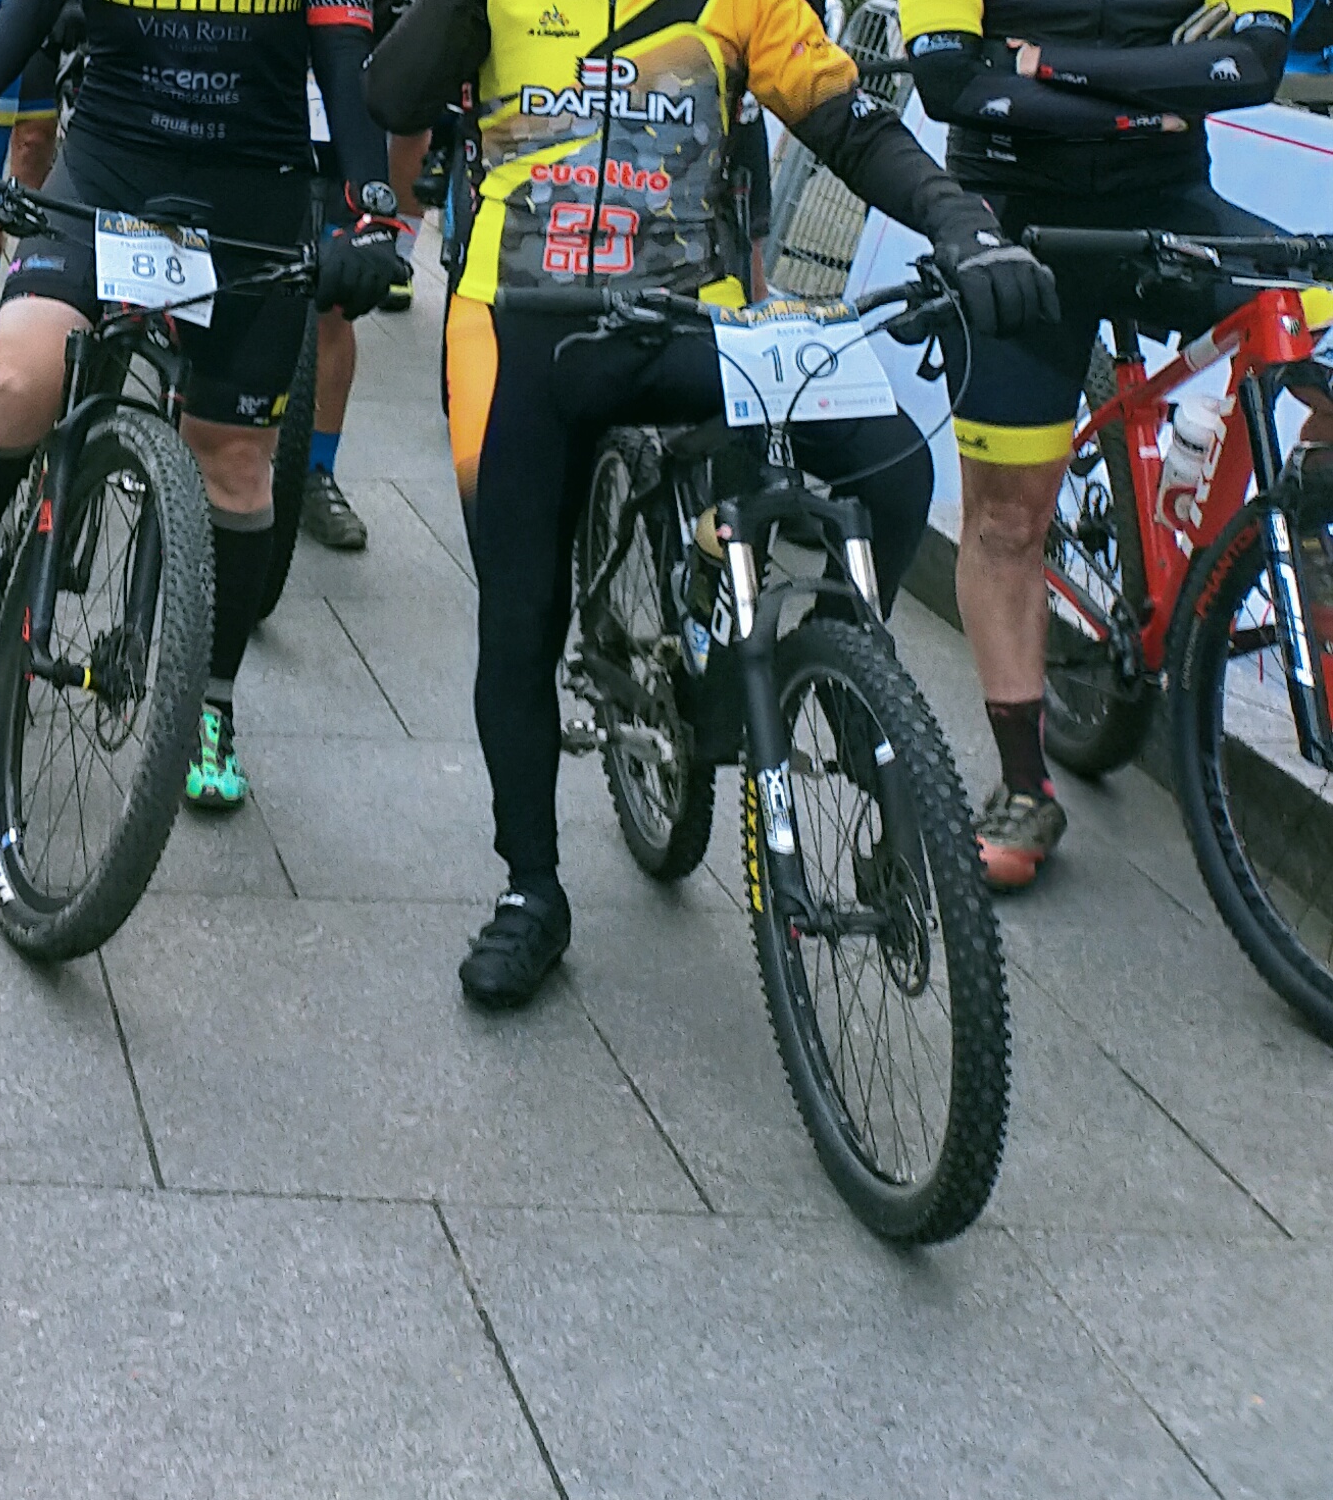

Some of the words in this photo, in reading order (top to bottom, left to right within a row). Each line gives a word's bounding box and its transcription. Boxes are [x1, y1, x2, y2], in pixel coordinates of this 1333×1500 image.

[160, 68, 242, 92] cenor
[133, 252, 186, 285] 88
[761, 342, 838, 383] 10
